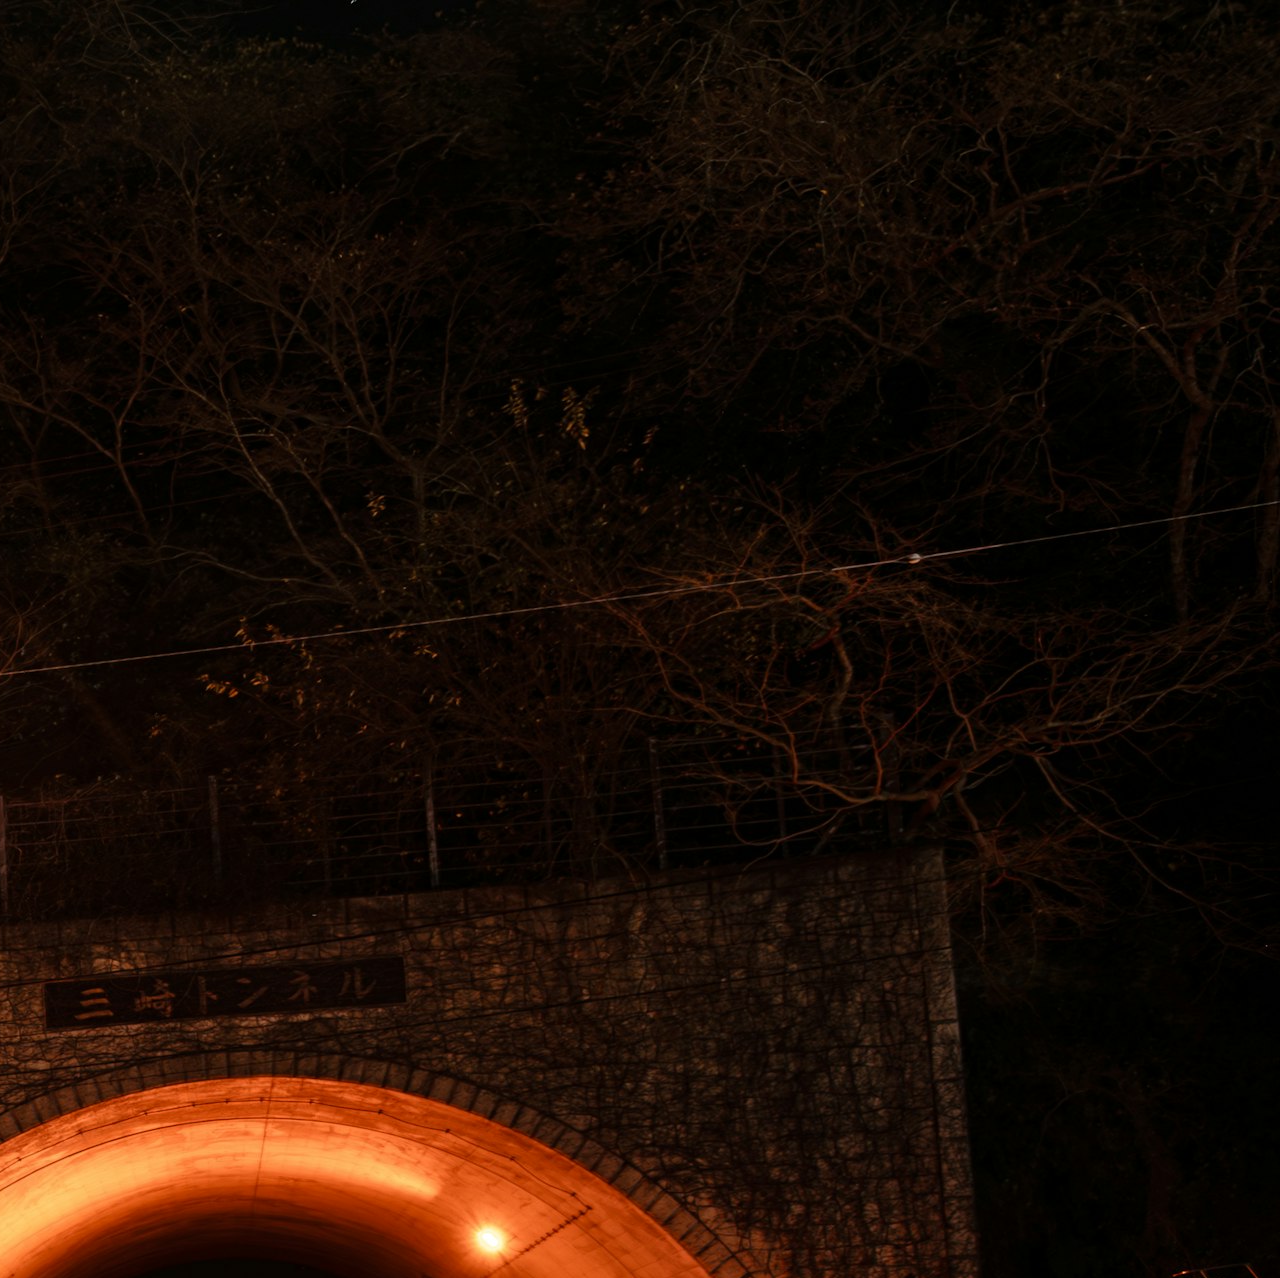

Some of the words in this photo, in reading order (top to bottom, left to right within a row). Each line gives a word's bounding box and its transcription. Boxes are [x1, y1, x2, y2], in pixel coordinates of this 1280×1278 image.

[73, 965, 377, 1020] 三崎トンネル
